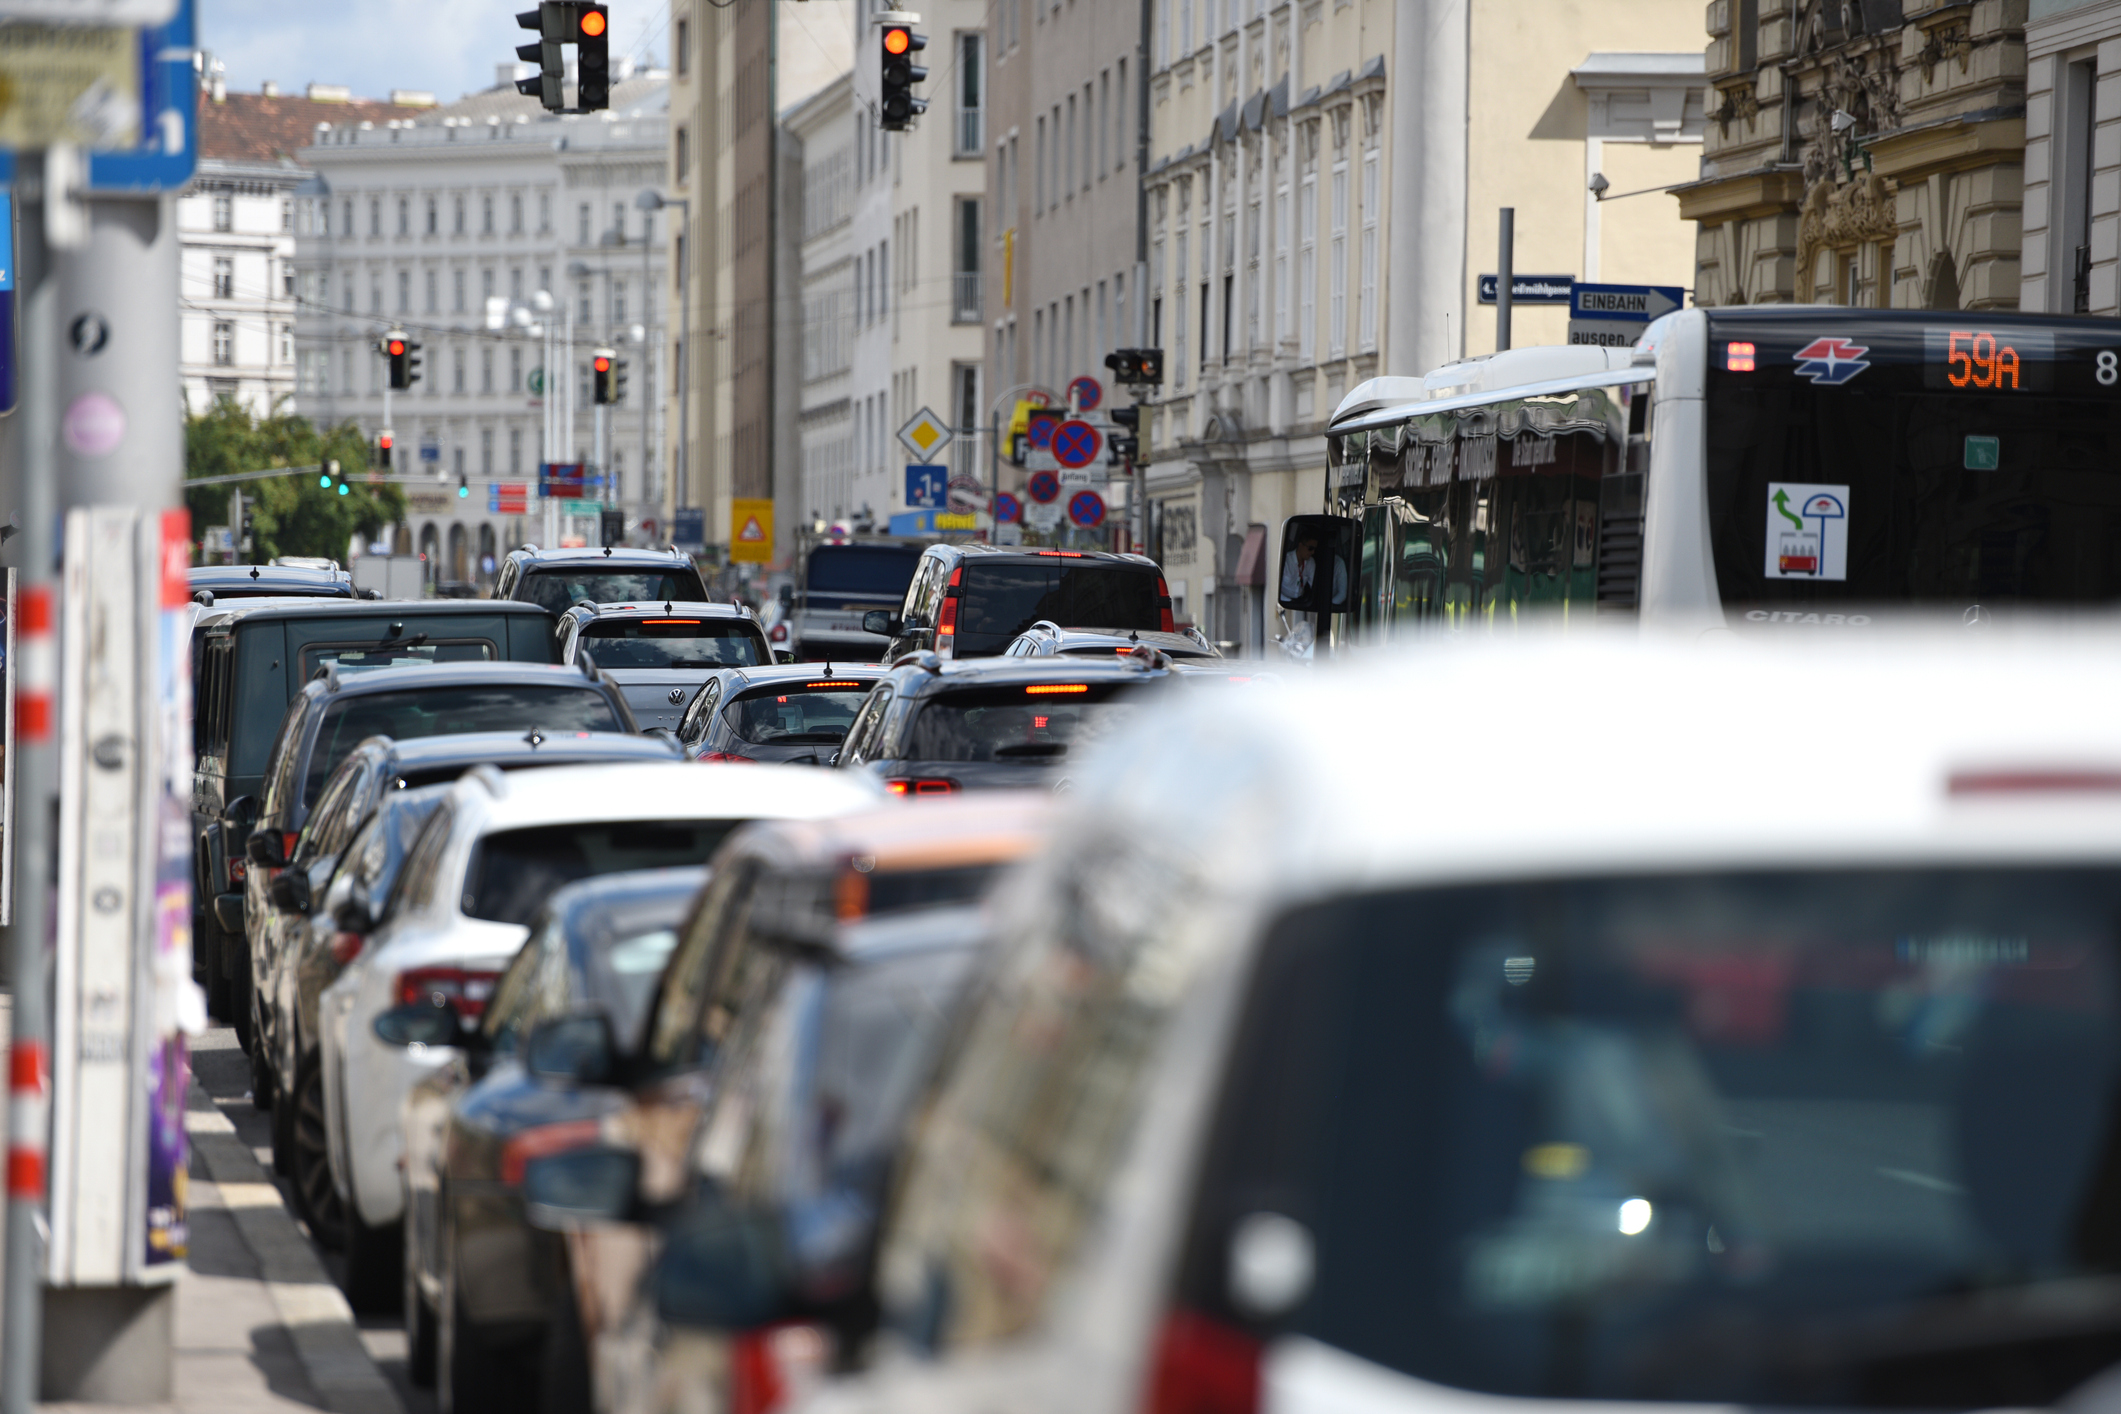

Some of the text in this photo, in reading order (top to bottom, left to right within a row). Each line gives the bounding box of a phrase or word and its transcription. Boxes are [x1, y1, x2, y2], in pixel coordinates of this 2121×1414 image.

[1582, 292, 1647, 311] EINBAHN
[1947, 330, 2020, 389] 59A
[2095, 350, 2119, 386] 8
[1745, 609, 1872, 627] CITARO
